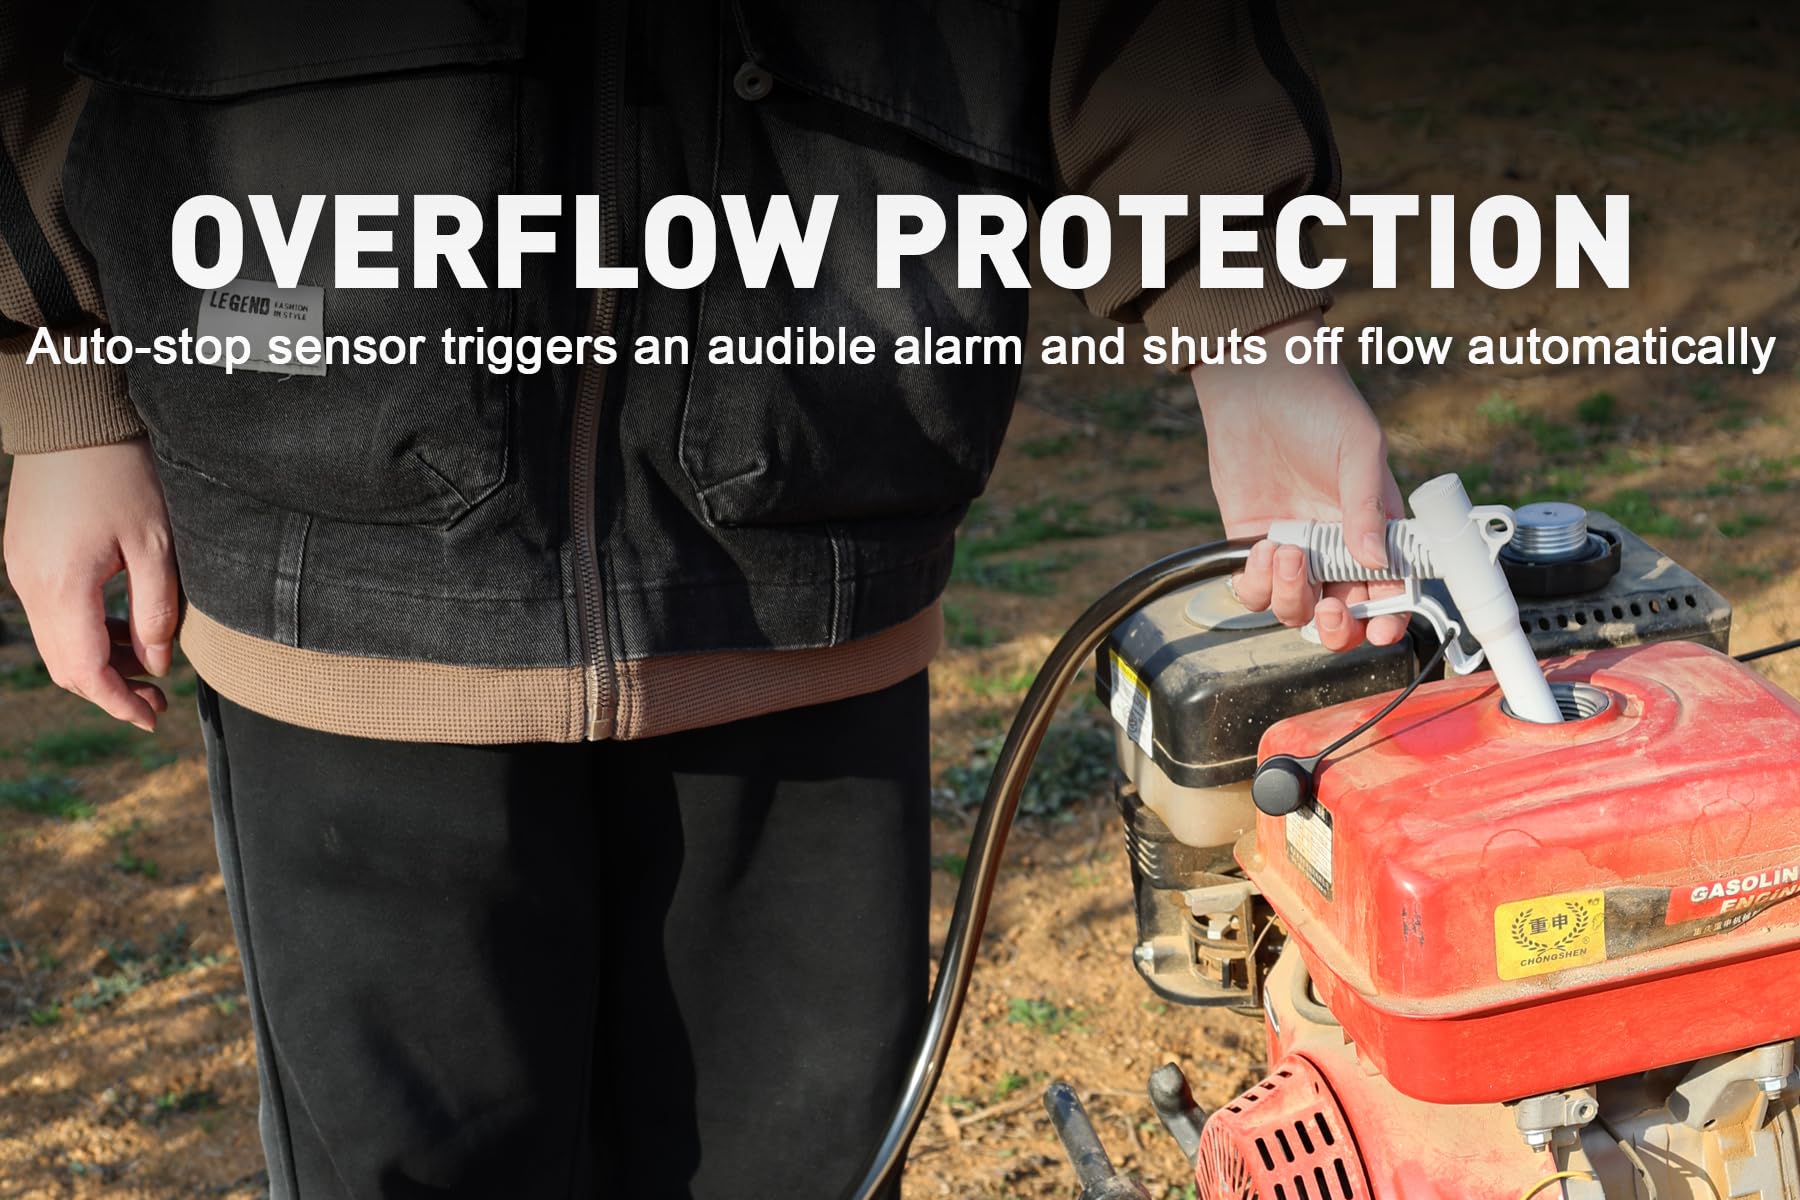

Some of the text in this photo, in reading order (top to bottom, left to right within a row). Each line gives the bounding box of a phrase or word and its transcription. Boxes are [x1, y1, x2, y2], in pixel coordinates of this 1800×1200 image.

[209, 290, 270, 316] LEGEND
[274, 301, 308, 312] FASHION
[283, 310, 306, 320] STYLE
[1690, 866, 1799, 903] GASOLIN
[1529, 913, 1568, 936] 重申
[1520, 948, 1587, 967] CHONGSHEN
